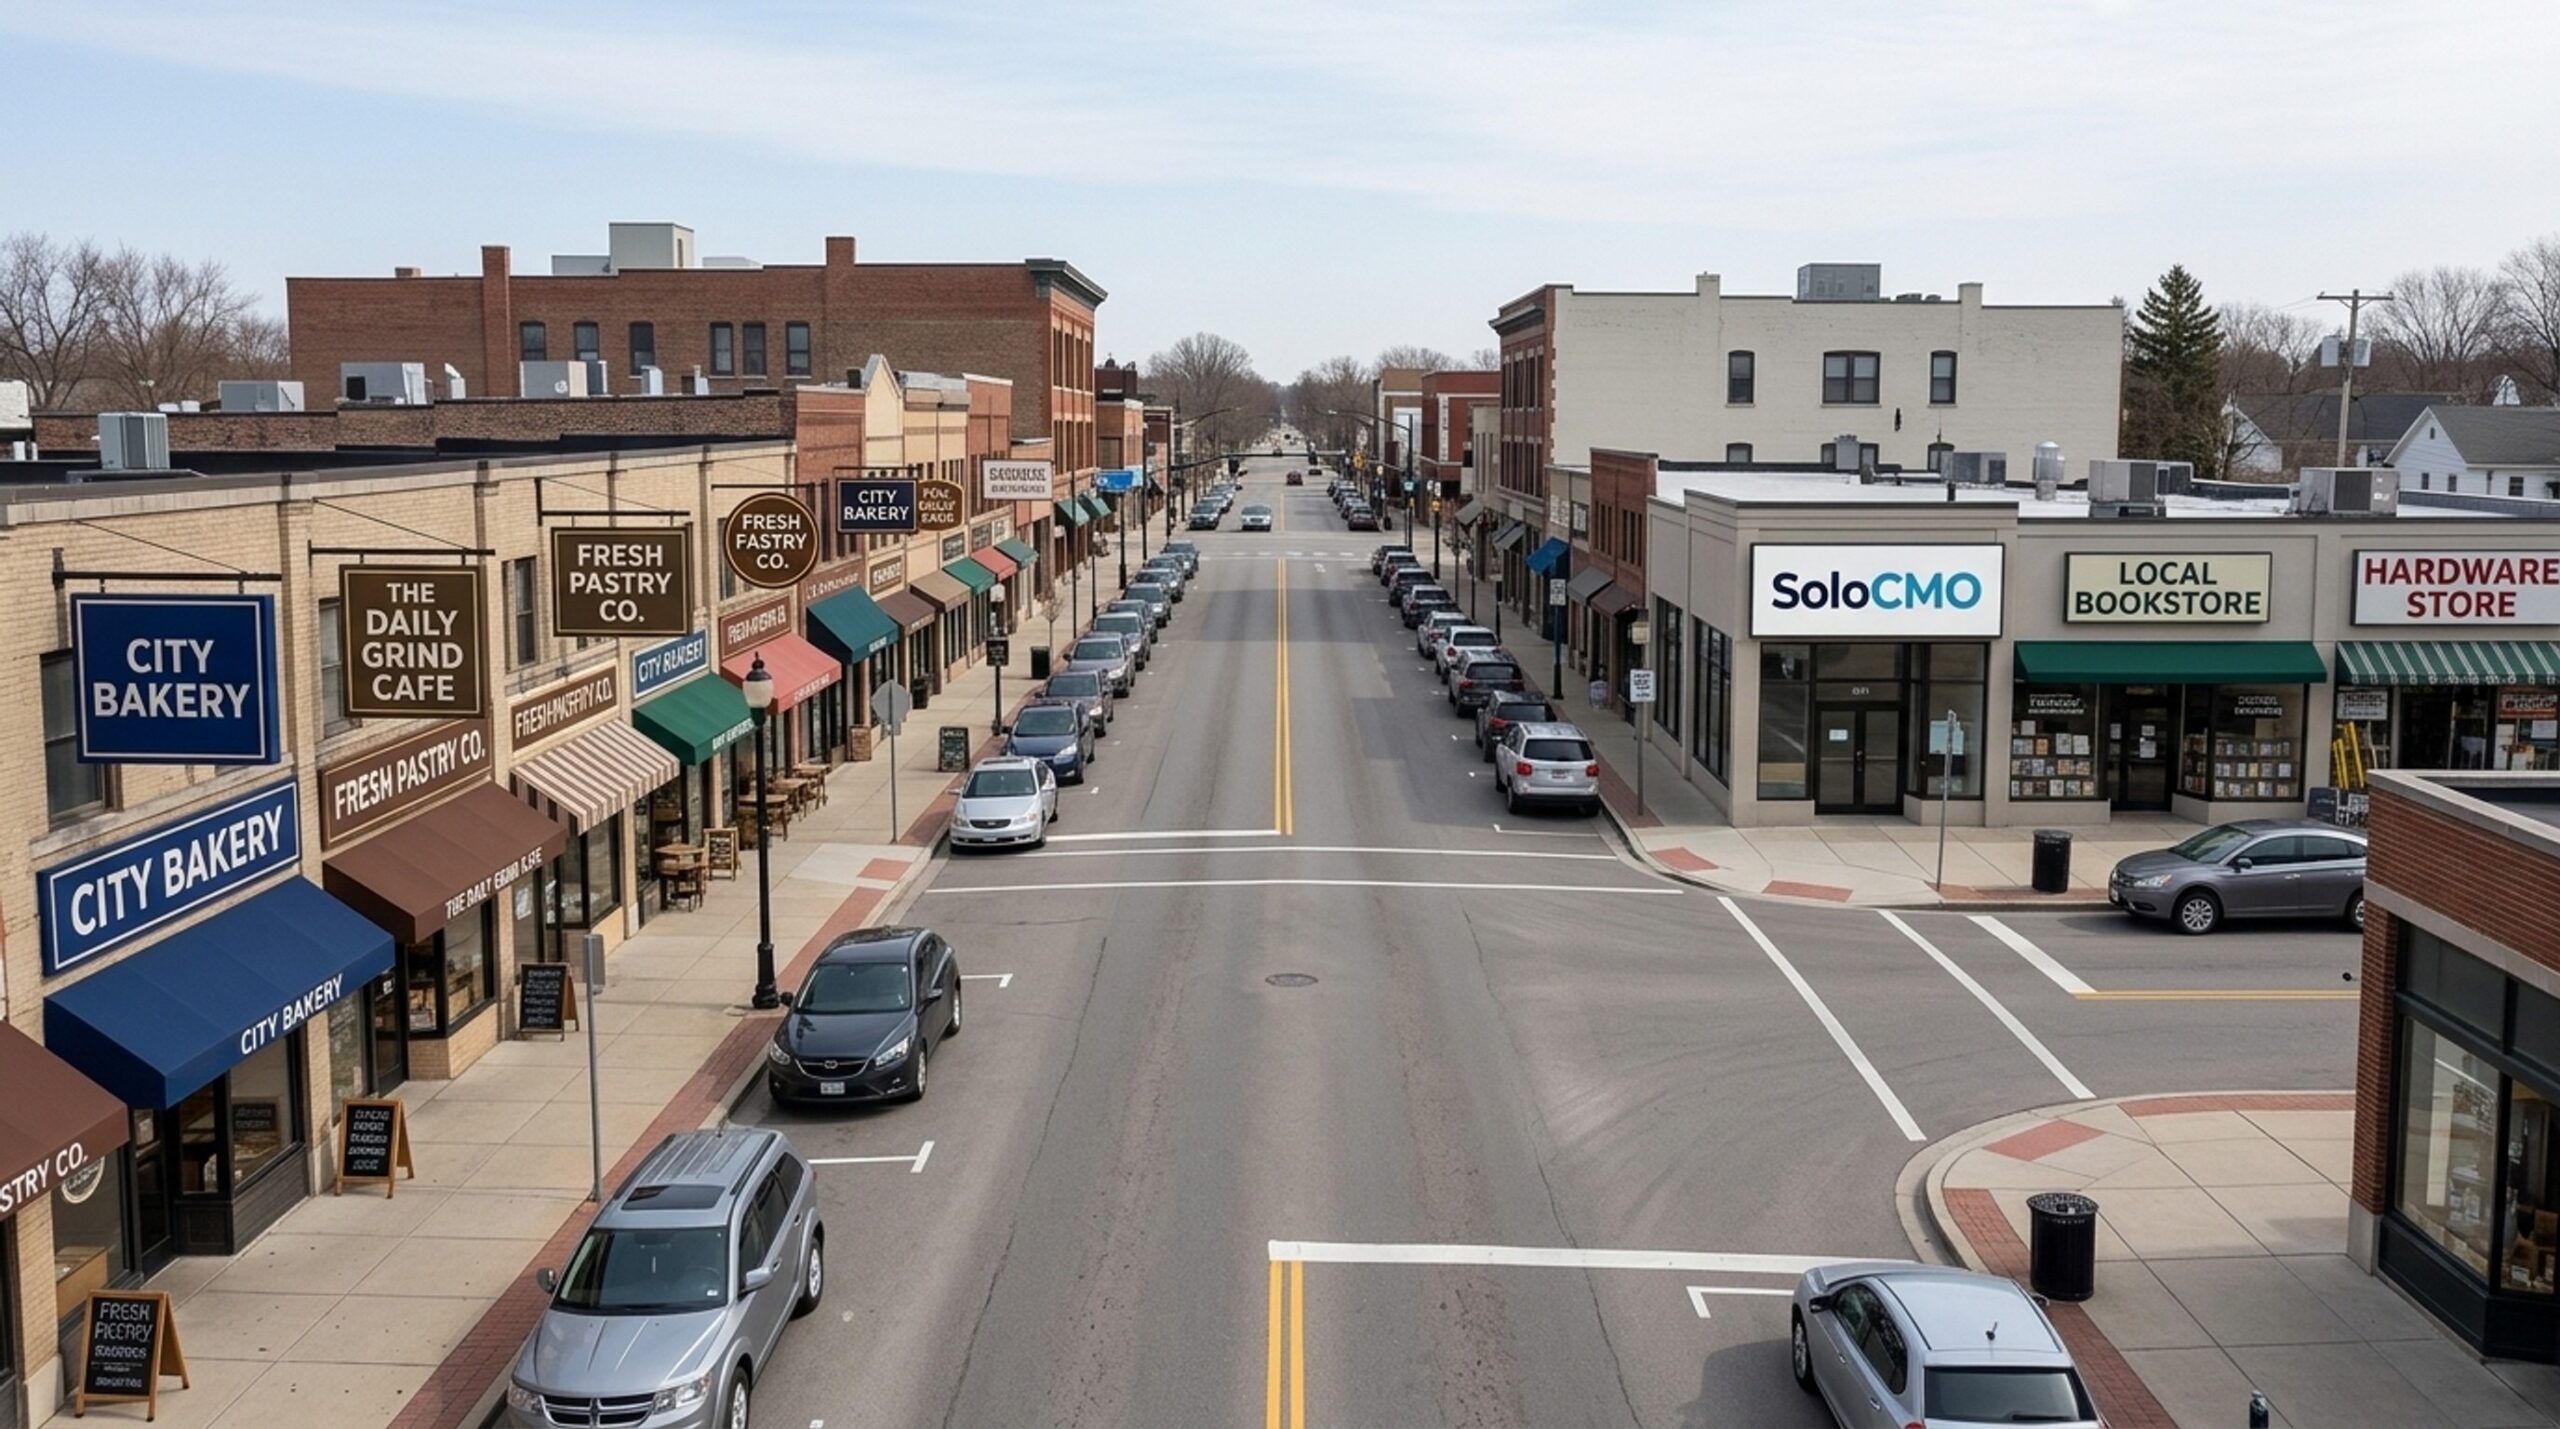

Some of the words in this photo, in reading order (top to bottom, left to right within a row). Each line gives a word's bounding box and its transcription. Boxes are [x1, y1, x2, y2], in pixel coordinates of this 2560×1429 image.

[858, 489, 897, 504] CITY
[742, 514, 800, 530] FRESH
[578, 544, 663, 567] FRESH
[756, 553, 789, 569] CO.
[570, 572, 672, 595] PASTRY
[2119, 561, 2218, 585] LOCAL
[2365, 558, 2560, 585] HARDWARE
[386, 583, 435, 603] THE
[1772, 571, 1982, 610] SoloCMO
[2075, 591, 2262, 615] BOOKSTORE
[600, 600, 645, 623] CO.
[2407, 591, 2517, 618] STORE
[366, 610, 459, 636] DAILY
[126, 638, 215, 674] CITY
[361, 643, 464, 669] GRIND
[93, 682, 250, 719] BAKERY
[372, 674, 455, 701] CAFE
[397, 737, 457, 794] PASTRY
[460, 729, 486, 764] CO.
[71, 858, 152, 937] CITY
[162, 805, 283, 899] BAKERY
[241, 1013, 279, 1056] CITY
[282, 973, 343, 1031] BAKERY
[0, 1158, 50, 1213] STRY
[55, 1142, 88, 1177] CO.
[99, 1302, 151, 1321] FRESH
